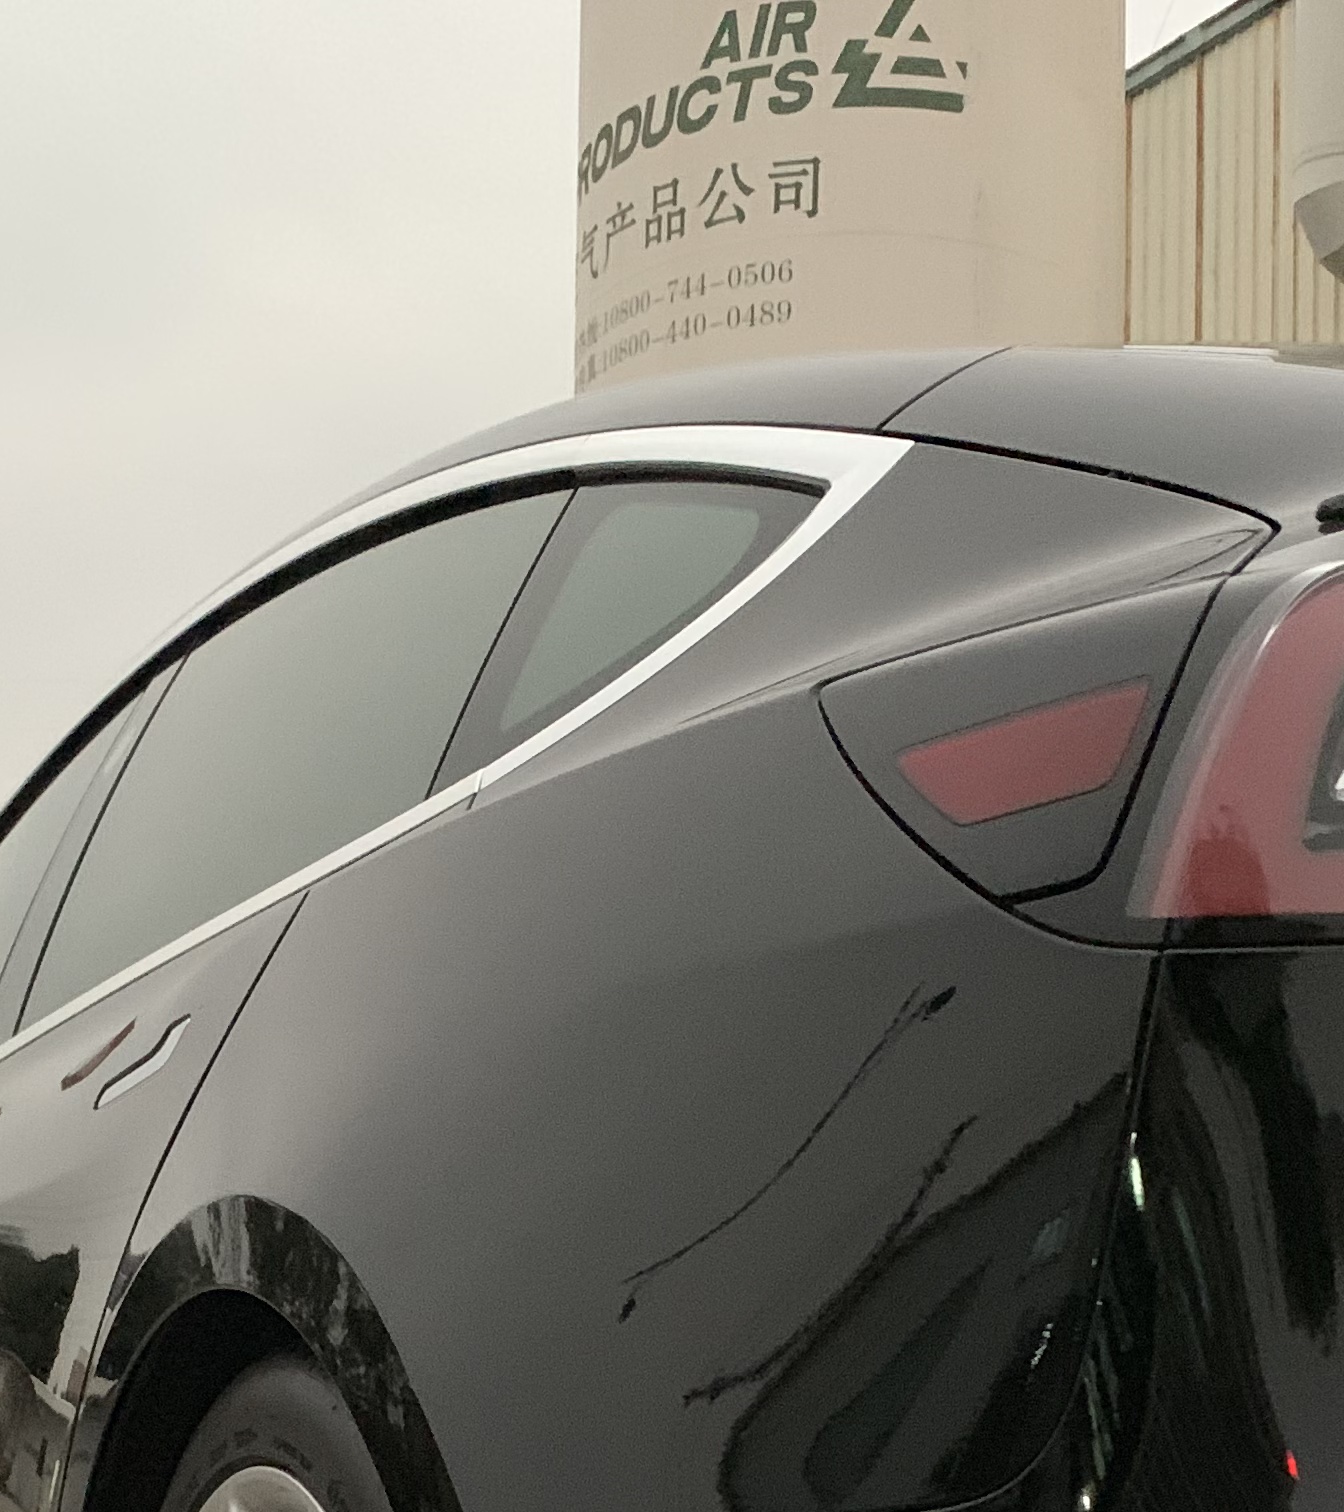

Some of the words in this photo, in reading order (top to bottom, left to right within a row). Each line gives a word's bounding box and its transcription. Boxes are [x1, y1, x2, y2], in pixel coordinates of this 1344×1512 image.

[700, 0, 817, 70] AIR
[581, 156, 820, 279] 气产品公司
